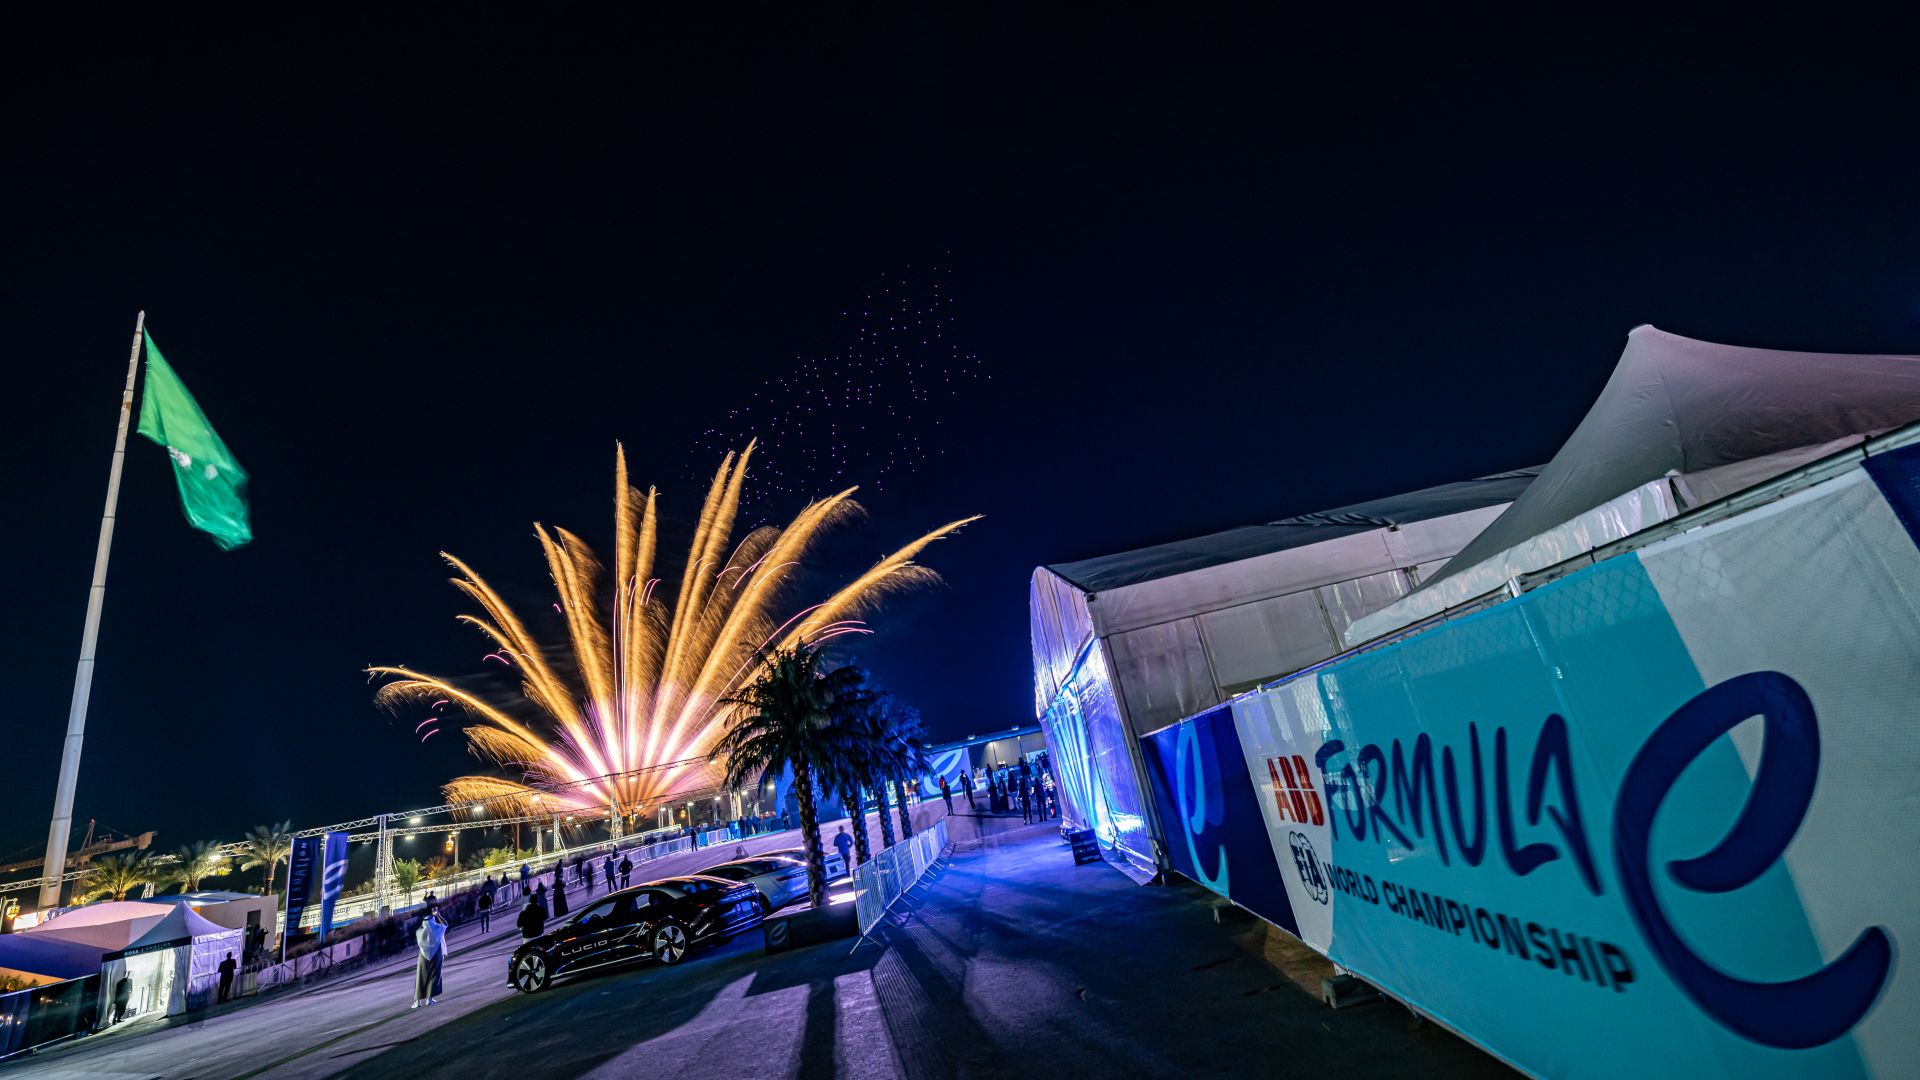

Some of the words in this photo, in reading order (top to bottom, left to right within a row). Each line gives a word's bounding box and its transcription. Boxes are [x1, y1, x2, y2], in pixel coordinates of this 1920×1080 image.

[1266, 754, 1325, 827] ABB
[1315, 713, 1605, 896] FORMULA
[1290, 844, 1327, 891] FIA
[561, 939, 608, 957] LUCID
[1323, 861, 1380, 906] WORLD
[1382, 879, 1637, 994] CHAMPIONSHIP
